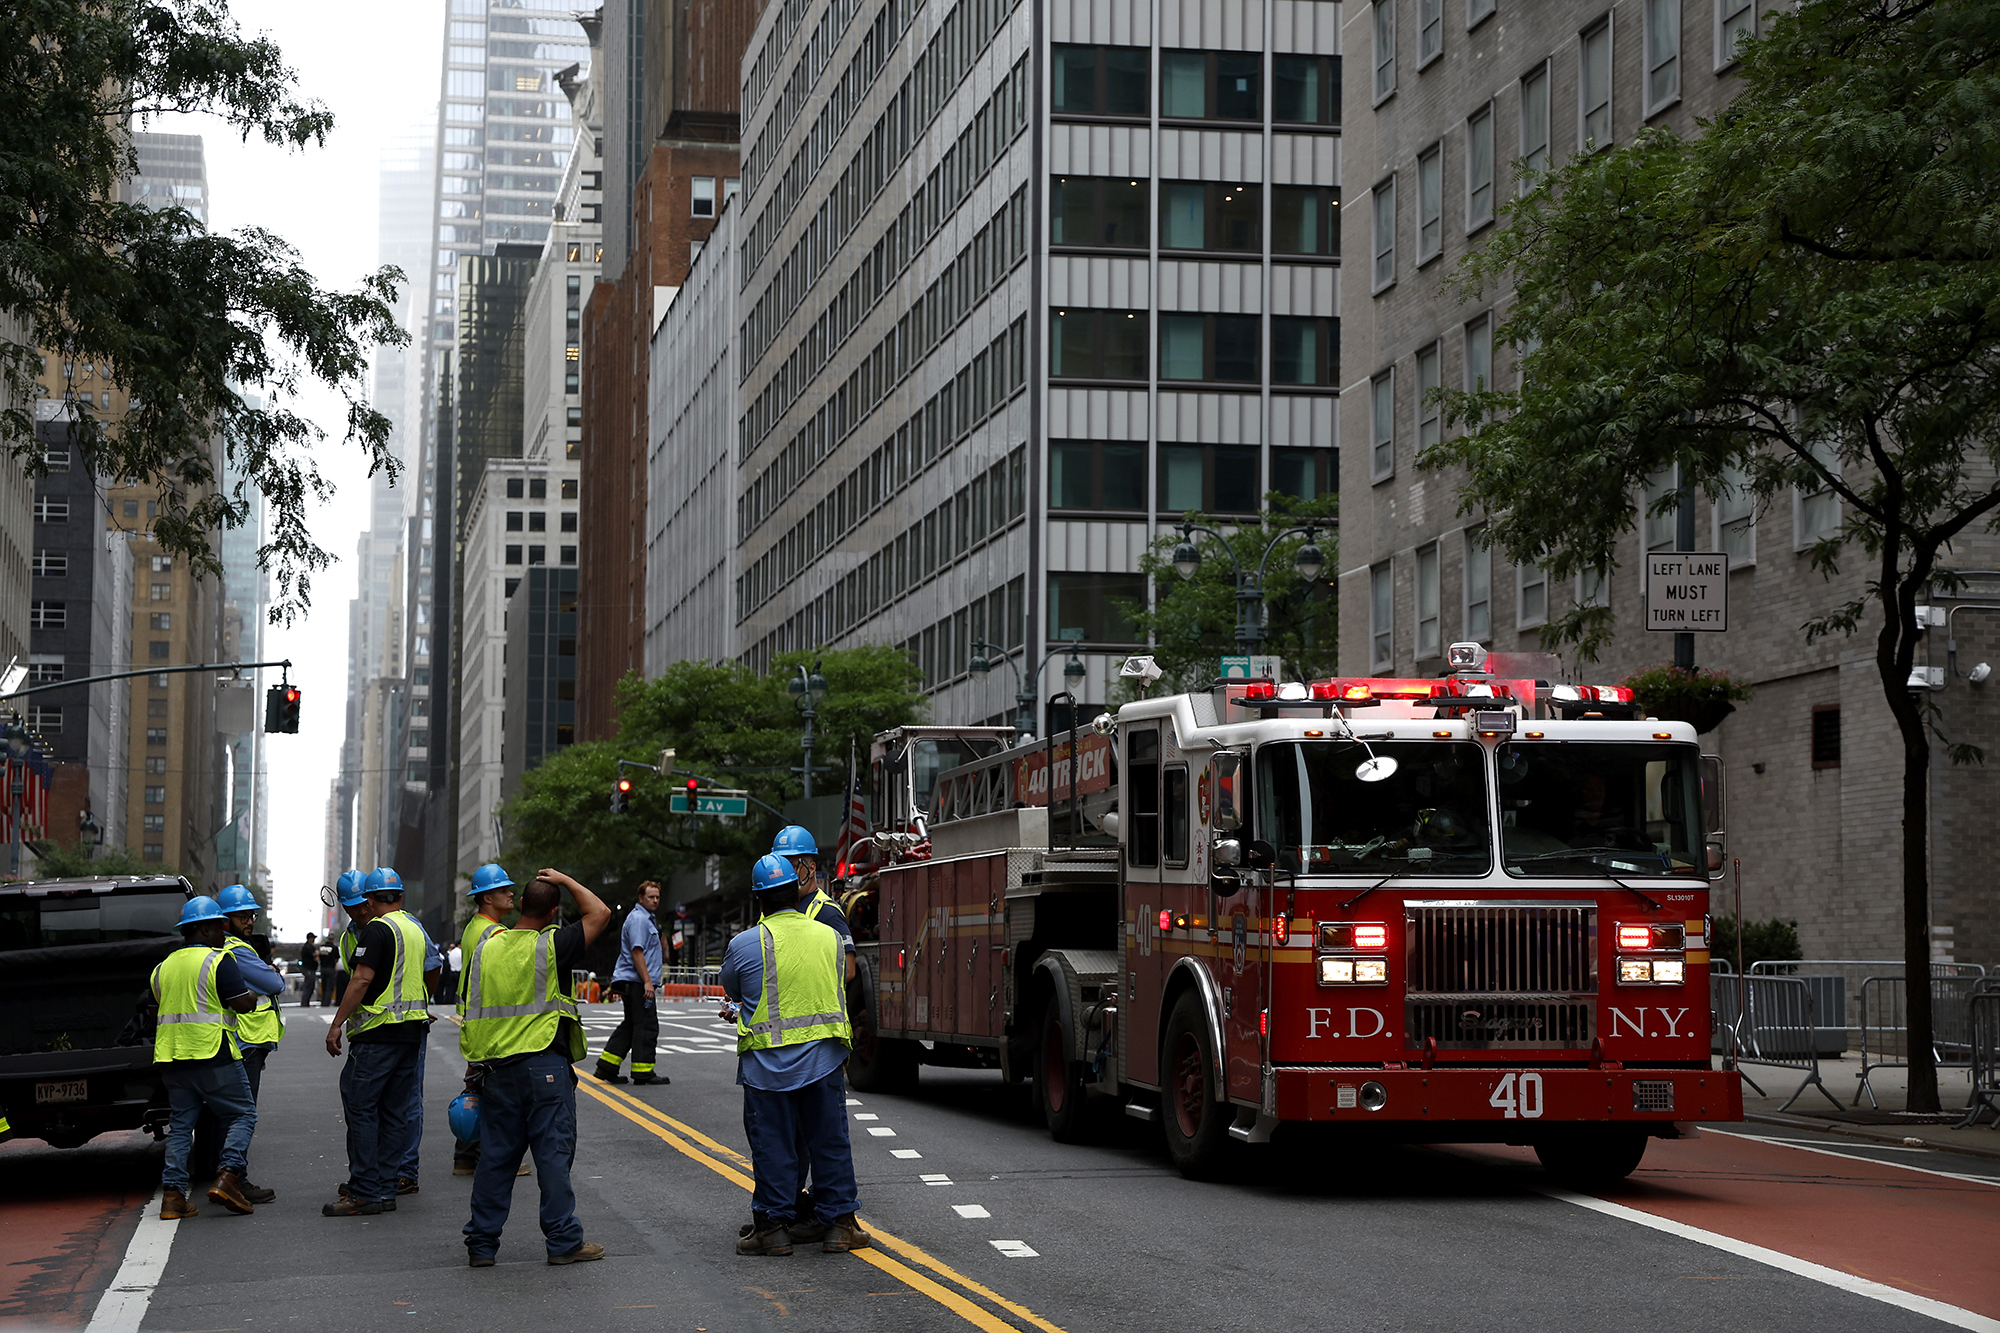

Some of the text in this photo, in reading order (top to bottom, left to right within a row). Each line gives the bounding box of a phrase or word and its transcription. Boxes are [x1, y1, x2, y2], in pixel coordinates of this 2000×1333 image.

[1653, 563, 1721, 576] LEFT LANE
[1666, 585, 1708, 600] MUST
[1653, 609, 1721, 622] TURN LEFT
[1028, 766, 1048, 795] 40
[705, 800, 724, 812] Av
[1136, 904, 1152, 957] 40
[1305, 1007, 1393, 1039] F.D.
[1607, 1006, 1695, 1038] N.Y.
[1489, 1072, 1544, 1119] 40
